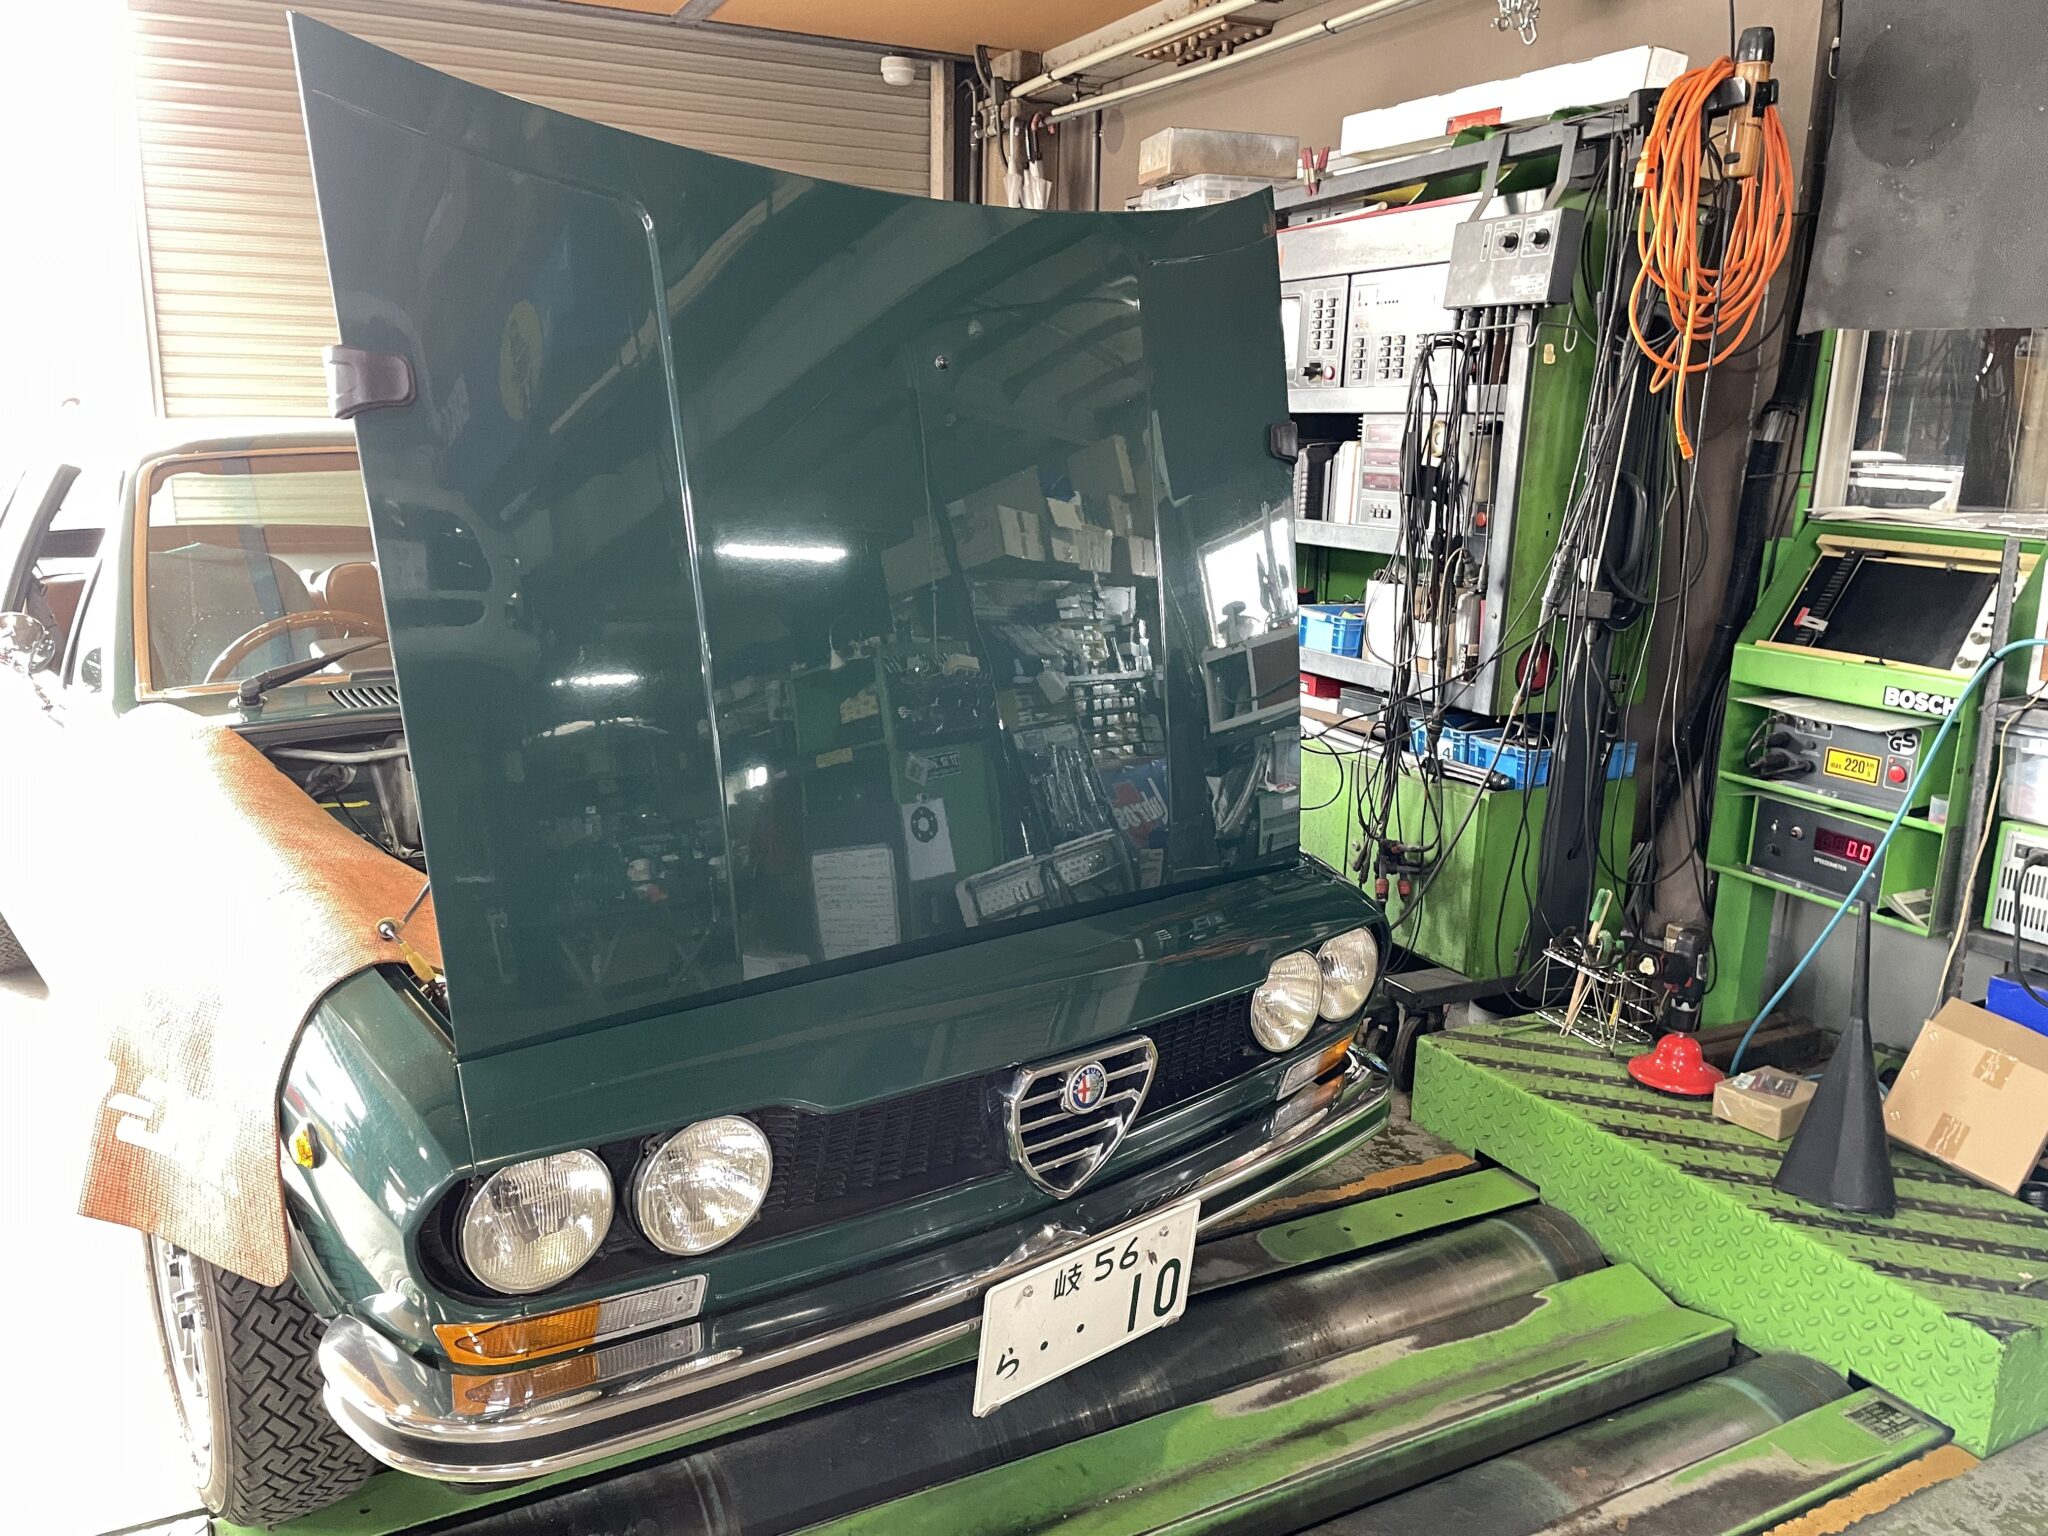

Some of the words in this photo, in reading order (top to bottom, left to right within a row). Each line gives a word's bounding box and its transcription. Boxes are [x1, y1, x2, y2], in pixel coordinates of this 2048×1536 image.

[1883, 686, 1960, 717] BOSCH
[1889, 732, 1916, 752] GS
[1844, 757, 1866, 774] 220
[1053, 1262, 1083, 1300] 岐
[1094, 1236, 1139, 1282] 56
[995, 1347, 1020, 1380] ら
[1127, 1257, 1181, 1333] 10
